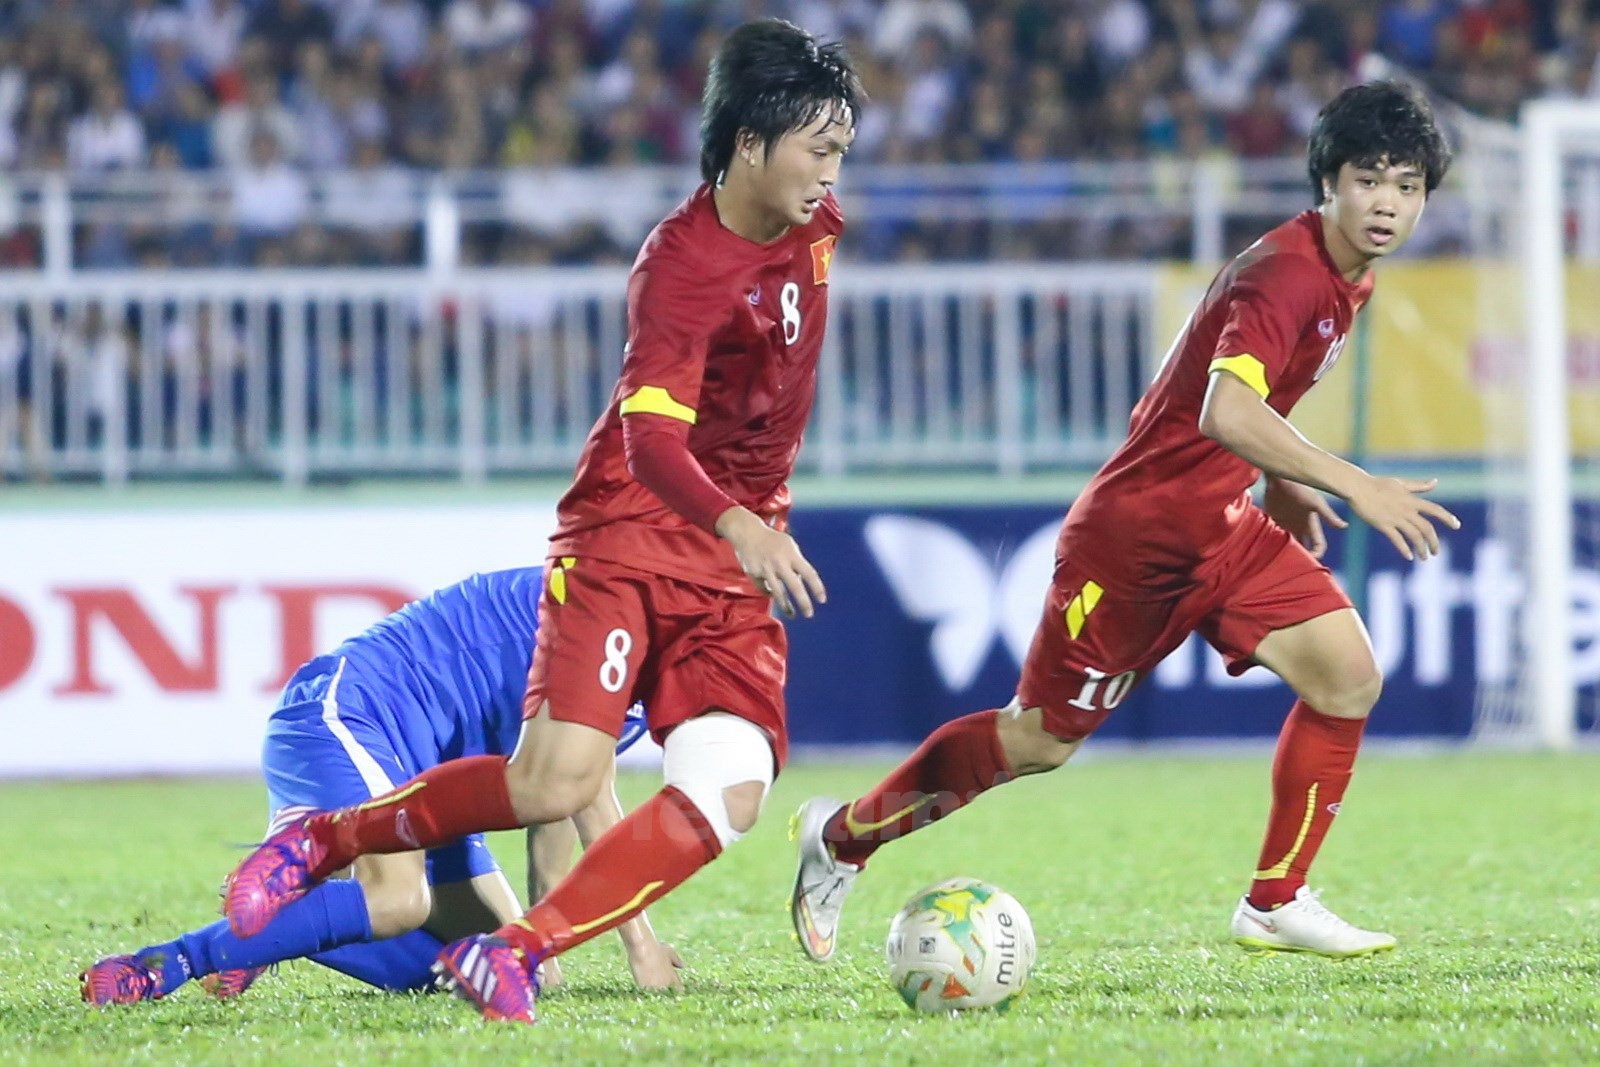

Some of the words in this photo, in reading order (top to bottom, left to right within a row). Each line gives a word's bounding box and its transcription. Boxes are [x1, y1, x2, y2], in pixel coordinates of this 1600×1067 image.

[780, 282, 801, 346] 8
[599, 627, 632, 692] 8
[1067, 666, 1136, 711] 10
[995, 911, 1016, 986] mitre
